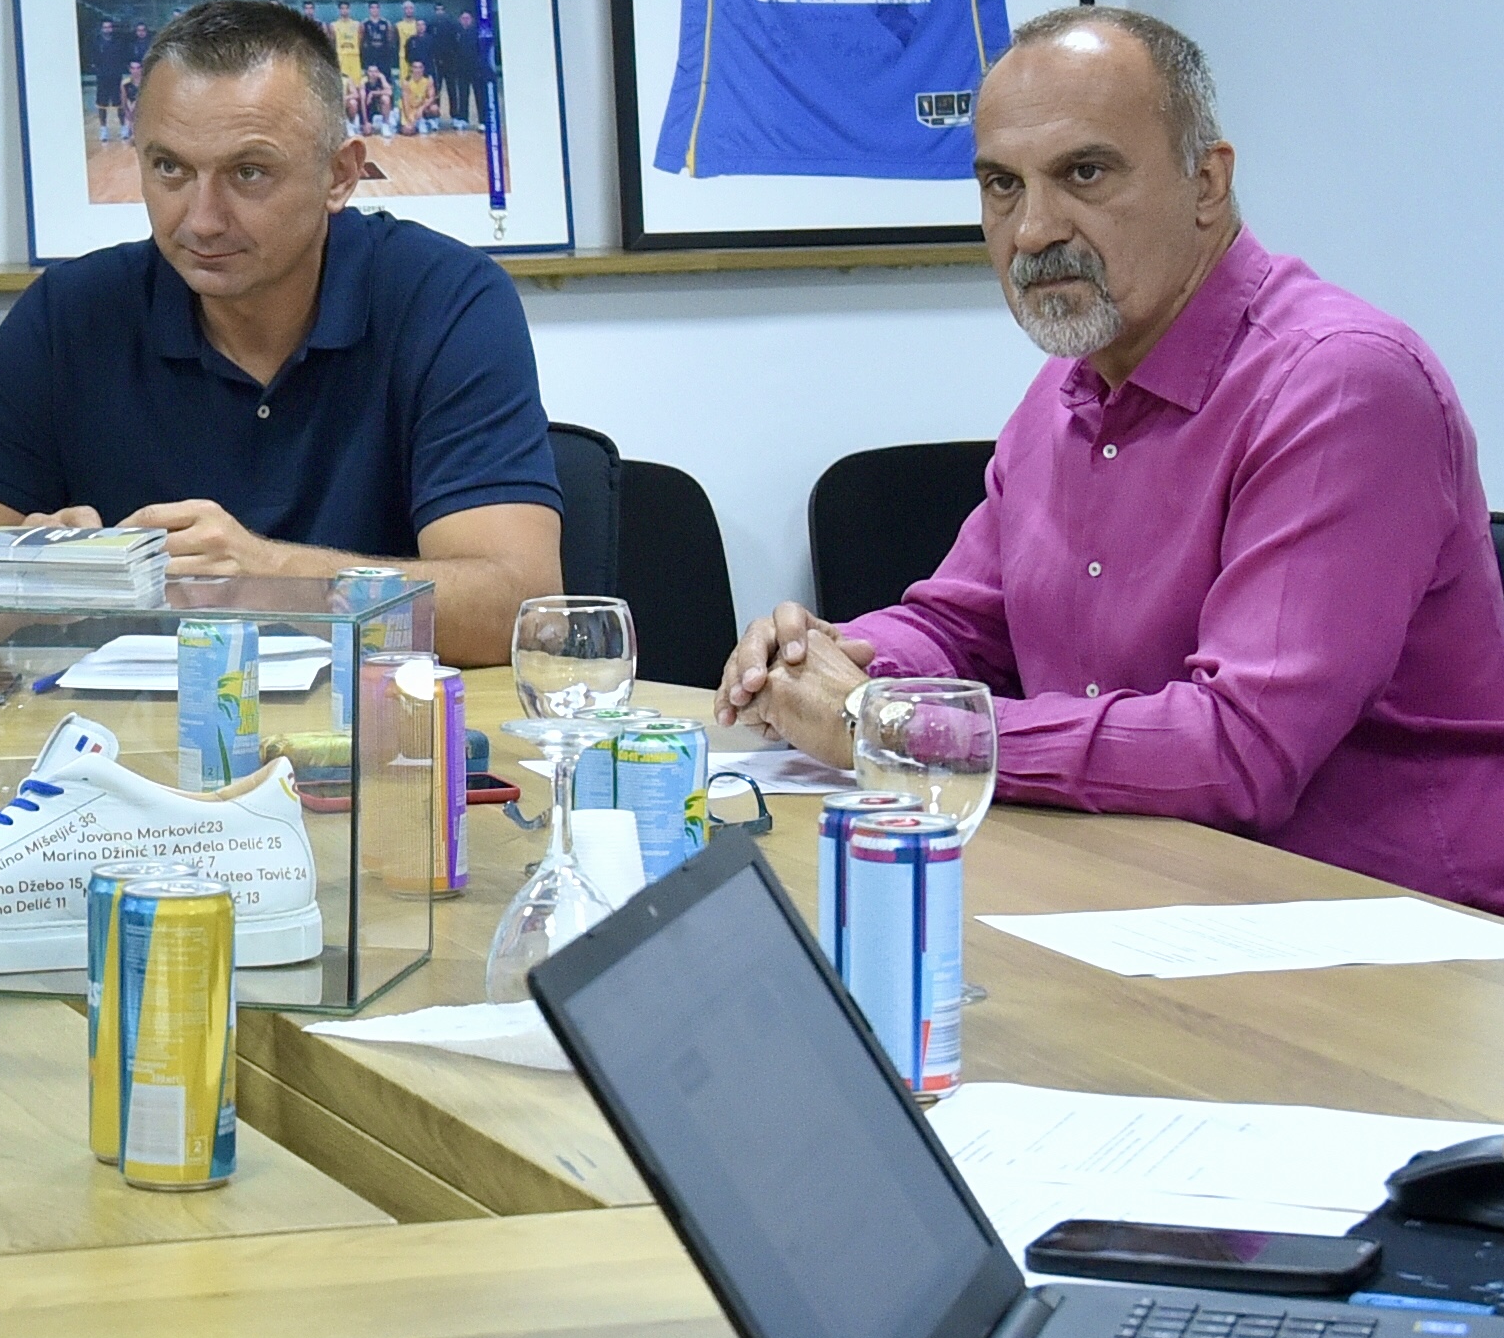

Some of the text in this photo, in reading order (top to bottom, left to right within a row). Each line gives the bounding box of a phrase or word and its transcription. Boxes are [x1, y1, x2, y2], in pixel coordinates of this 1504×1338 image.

[208, 766, 214, 776] 2
[25, 823, 78, 854] Mišeljić
[79, 812, 97, 830] 33
[76, 828, 133, 844] Jovana
[42, 837, 282, 863] Marina Džinić 12 Anđela Delić 25
[256, 866, 292, 881] Tavić
[294, 868, 307, 880] 24
[18, 879, 65, 893] Džebo
[246, 891, 261, 904] 13
[16, 899, 52, 915] Delić
[55, 897, 67, 908] 11
[193, 1140, 202, 1154] 2
